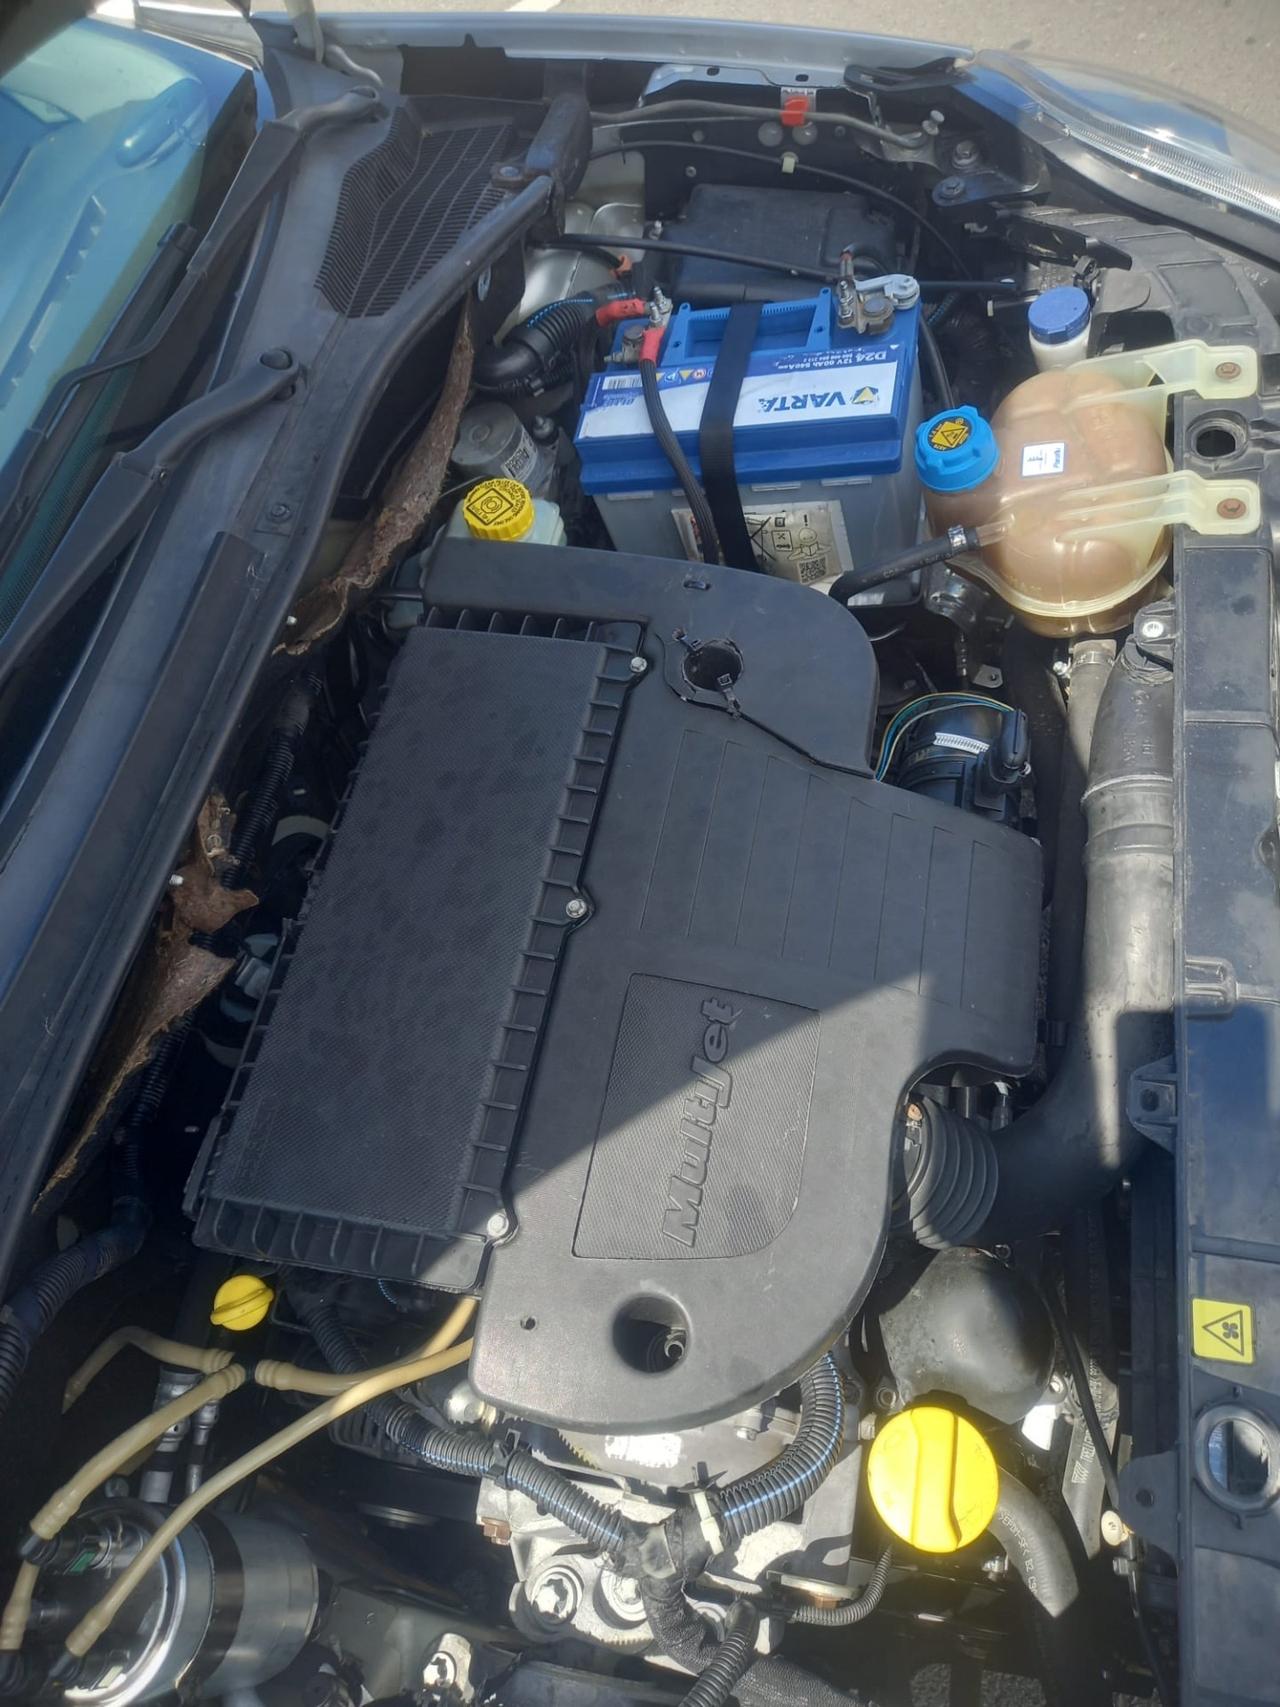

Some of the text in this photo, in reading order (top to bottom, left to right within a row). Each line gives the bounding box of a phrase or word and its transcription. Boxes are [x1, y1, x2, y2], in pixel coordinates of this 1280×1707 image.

[855, 350, 887, 361] D24
[758, 391, 846, 413] VARTA
[663, 998, 735, 1248] MultiJet
